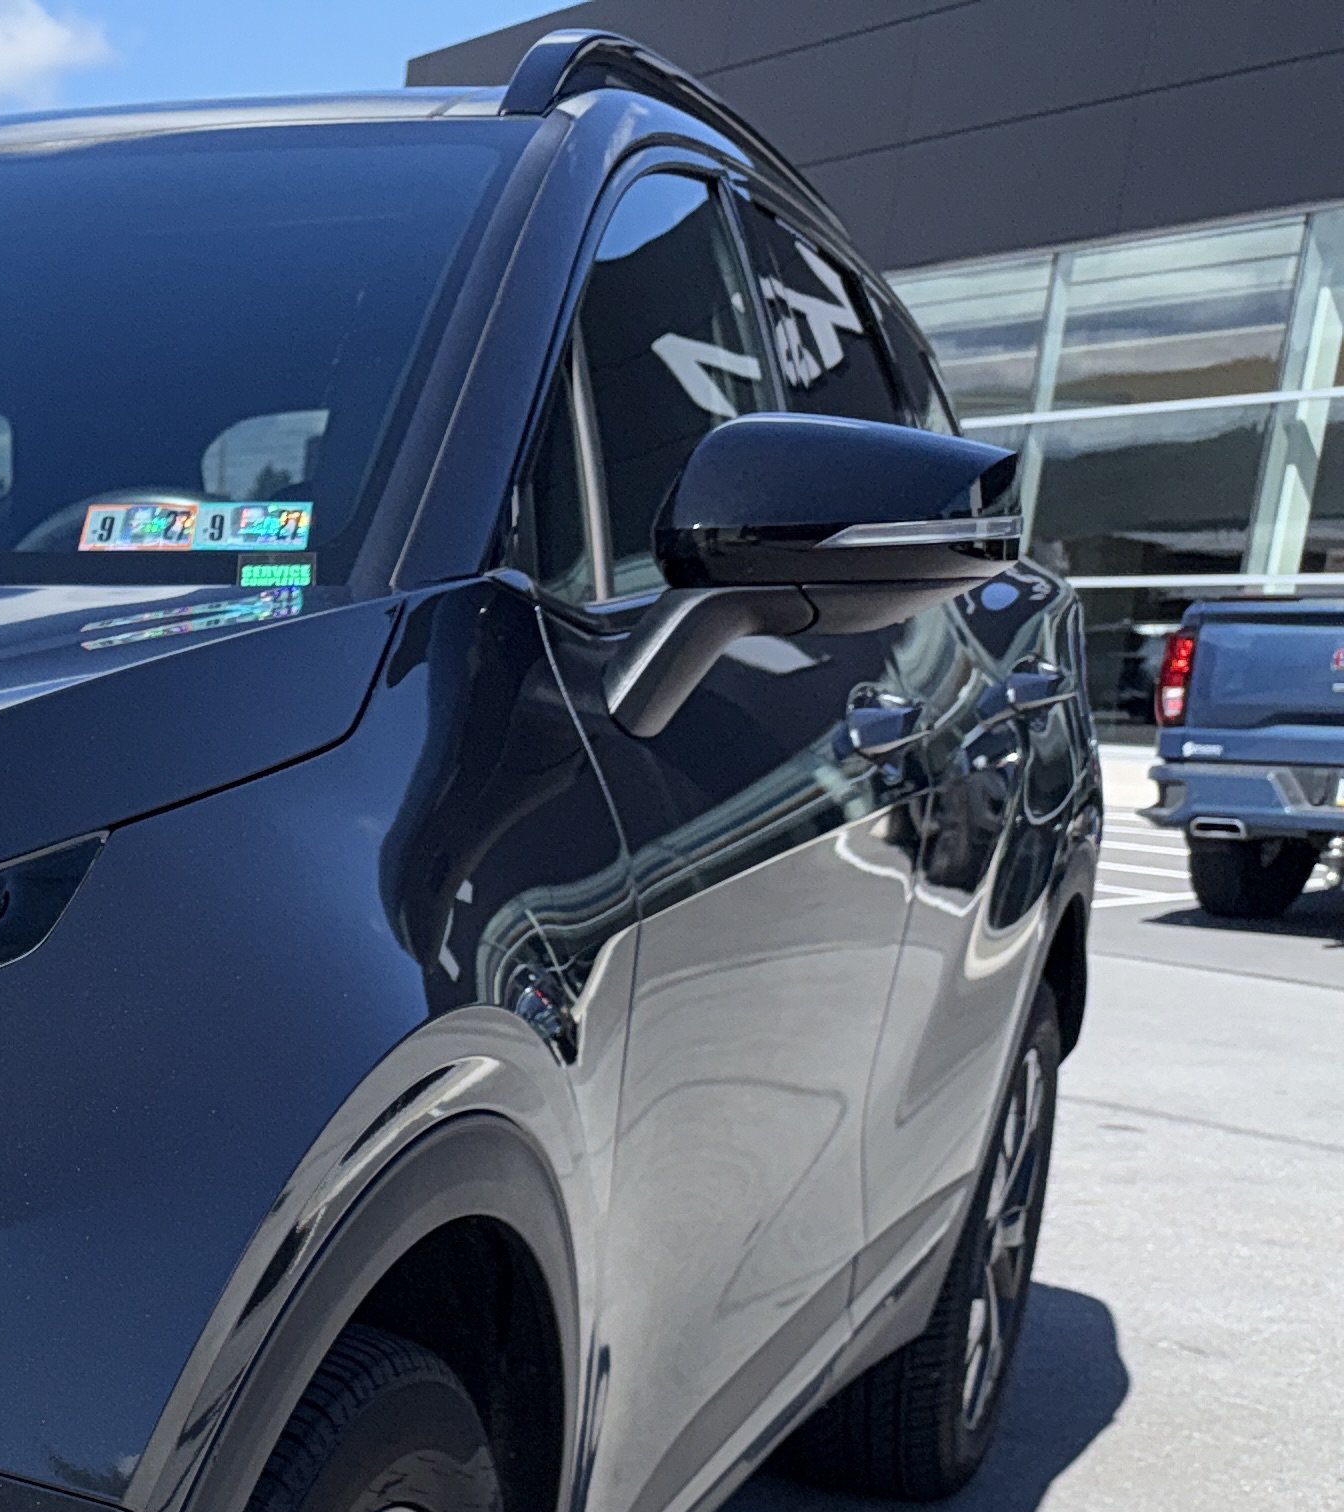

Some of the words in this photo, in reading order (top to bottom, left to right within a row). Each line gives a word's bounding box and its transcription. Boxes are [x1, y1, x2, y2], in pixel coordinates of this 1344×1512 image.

[97, 515, 115, 542] 9
[209, 514, 225, 541] 9
[241, 564, 311, 577] SERVICE
